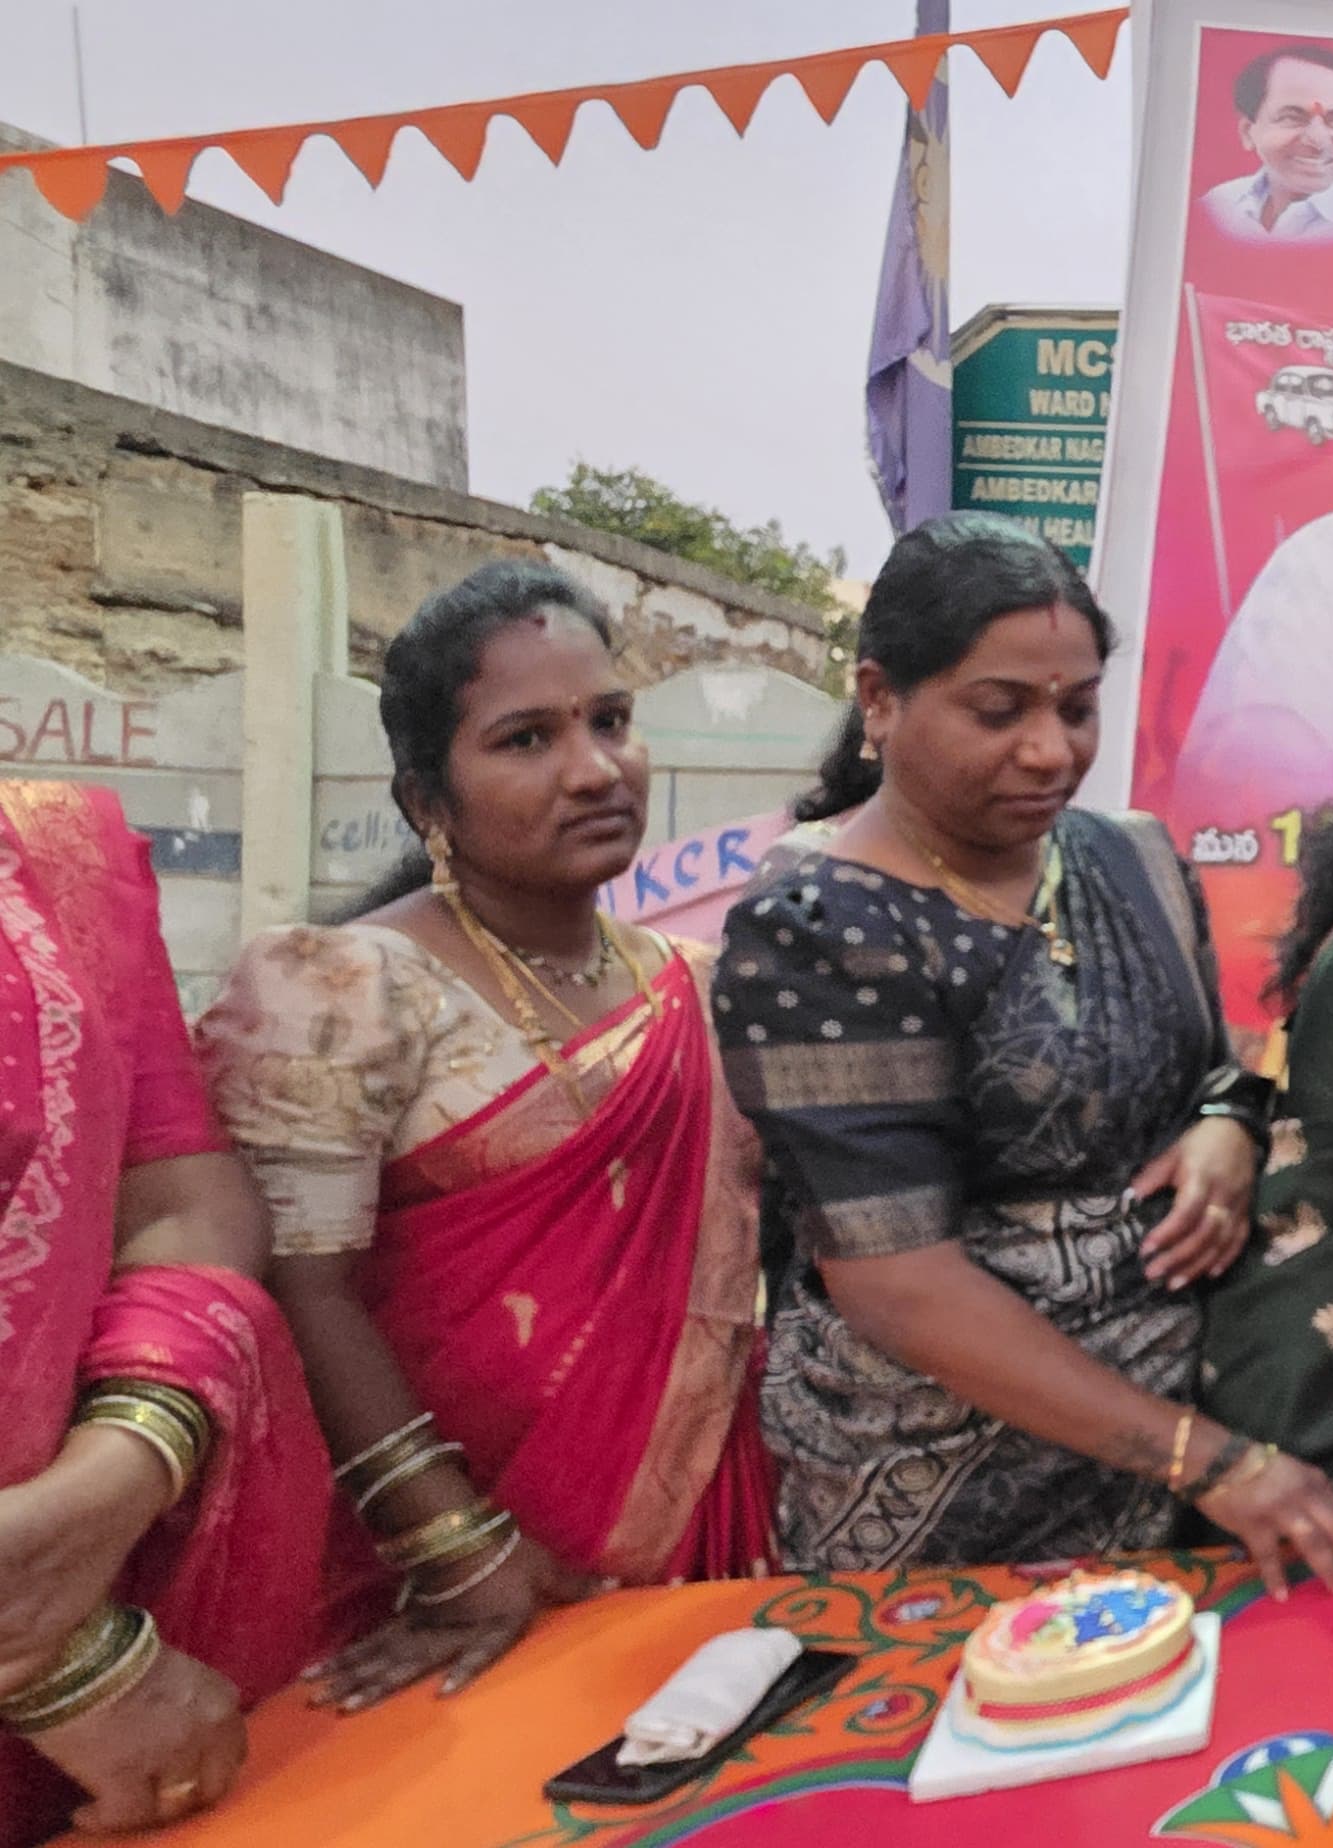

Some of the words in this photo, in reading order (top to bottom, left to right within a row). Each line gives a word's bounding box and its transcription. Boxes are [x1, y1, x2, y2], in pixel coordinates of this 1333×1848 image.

[1030, 389, 1096, 417] WARD
[962, 434, 1063, 461] AMBEDKAR
[634, 829, 757, 912] KCR
